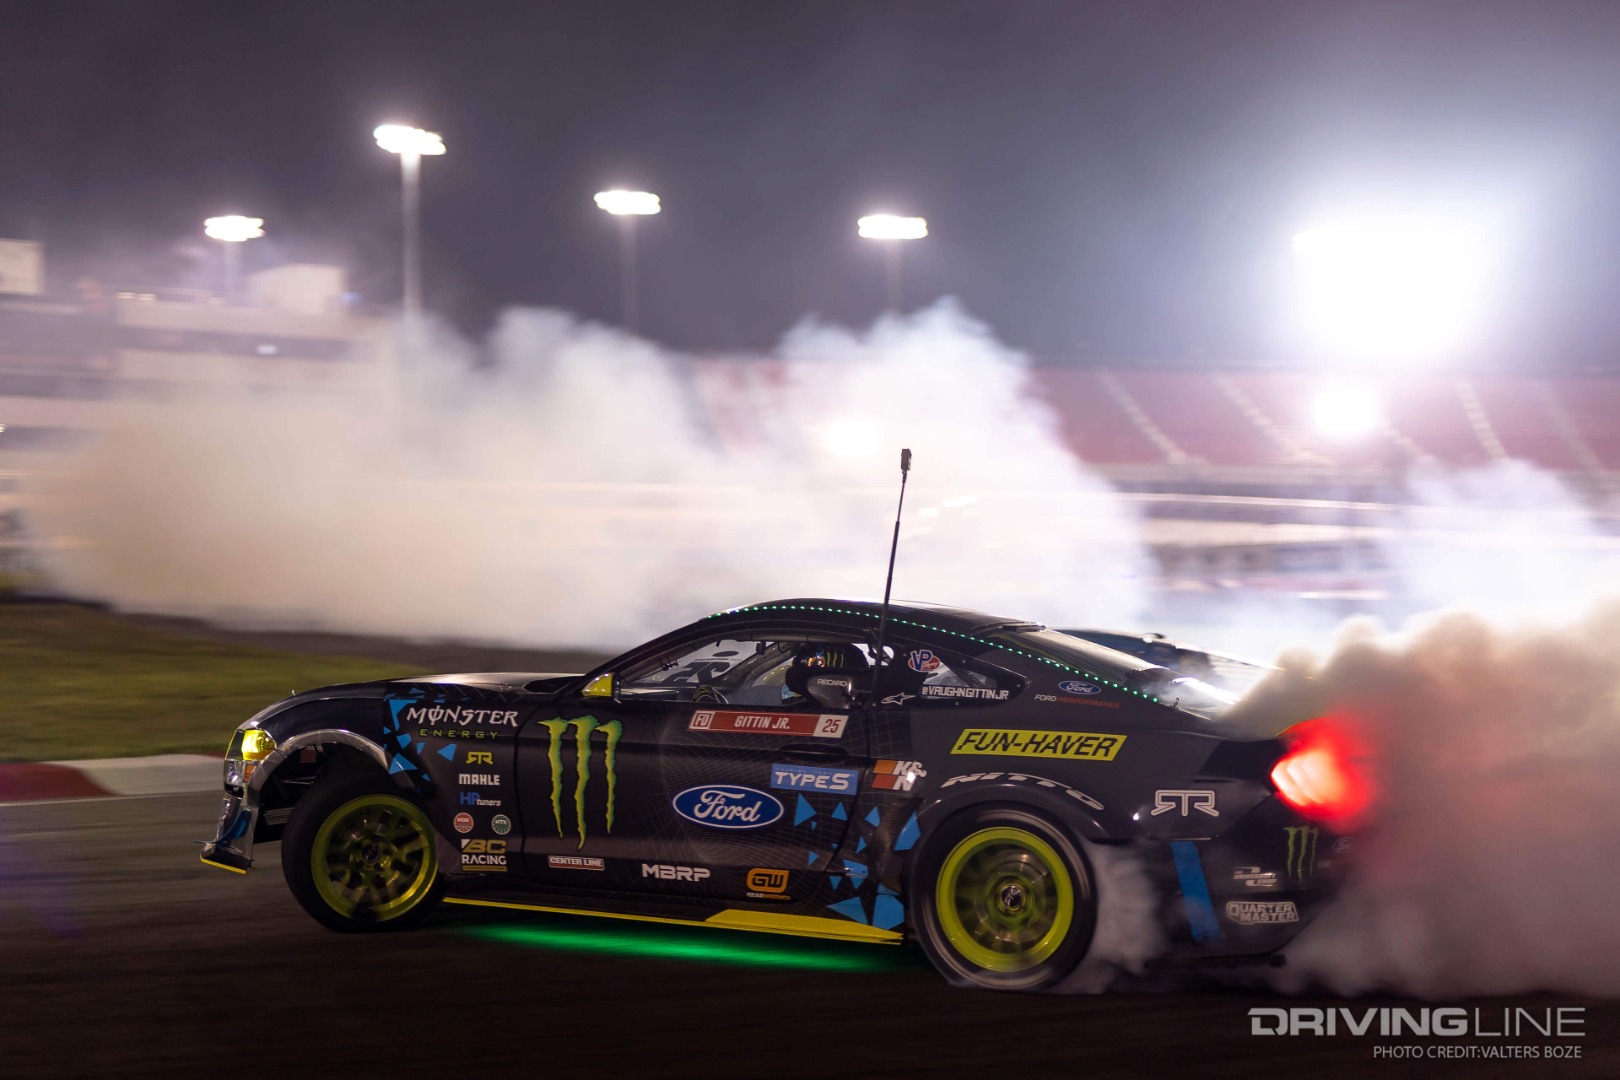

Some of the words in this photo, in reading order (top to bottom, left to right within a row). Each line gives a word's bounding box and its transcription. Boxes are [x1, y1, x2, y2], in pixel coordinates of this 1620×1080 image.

[910, 649, 934, 671] VP
[1066, 682, 1093, 693] Ford
[1034, 694, 1057, 702] FORD
[734, 715, 770, 728] GITTIN
[772, 718, 790, 729] JR.
[822, 718, 842, 733] 25
[420, 728, 498, 739] ENERGY
[957, 732, 1118, 757] FUN-HAVER
[459, 773, 500, 785] MAHLE
[694, 790, 762, 822] Ford
[461, 855, 507, 865] RACING
[550, 856, 582, 866] CENTER
[642, 863, 710, 882] MBRP
